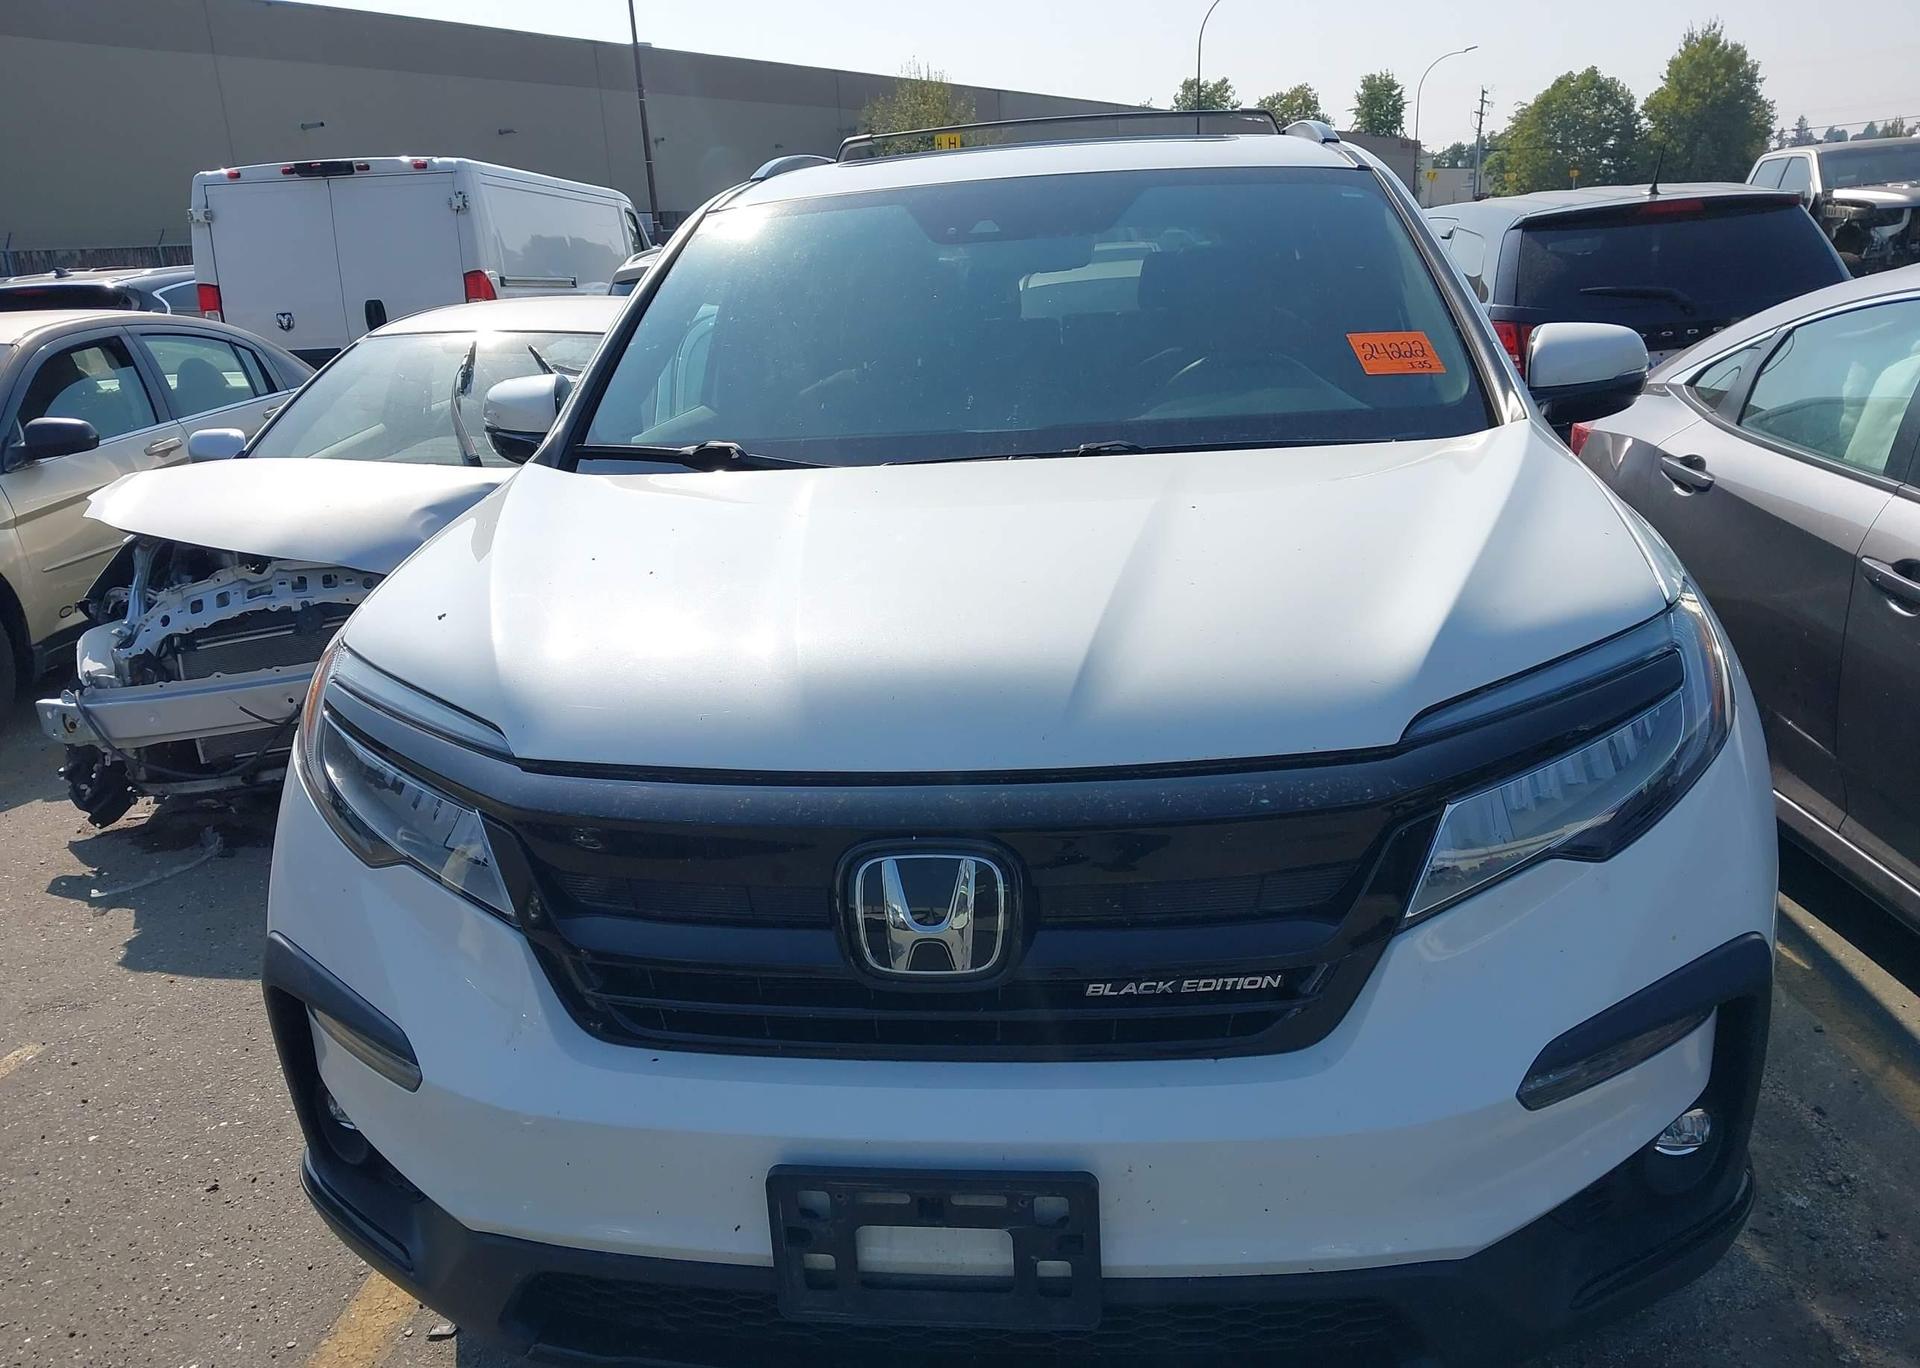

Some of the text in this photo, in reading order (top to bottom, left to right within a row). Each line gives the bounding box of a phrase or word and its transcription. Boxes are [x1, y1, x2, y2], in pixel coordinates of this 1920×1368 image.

[948, 136, 957, 149] H
[1361, 340, 1428, 361] 24222
[1086, 975, 1282, 997] BLACK EDITION
